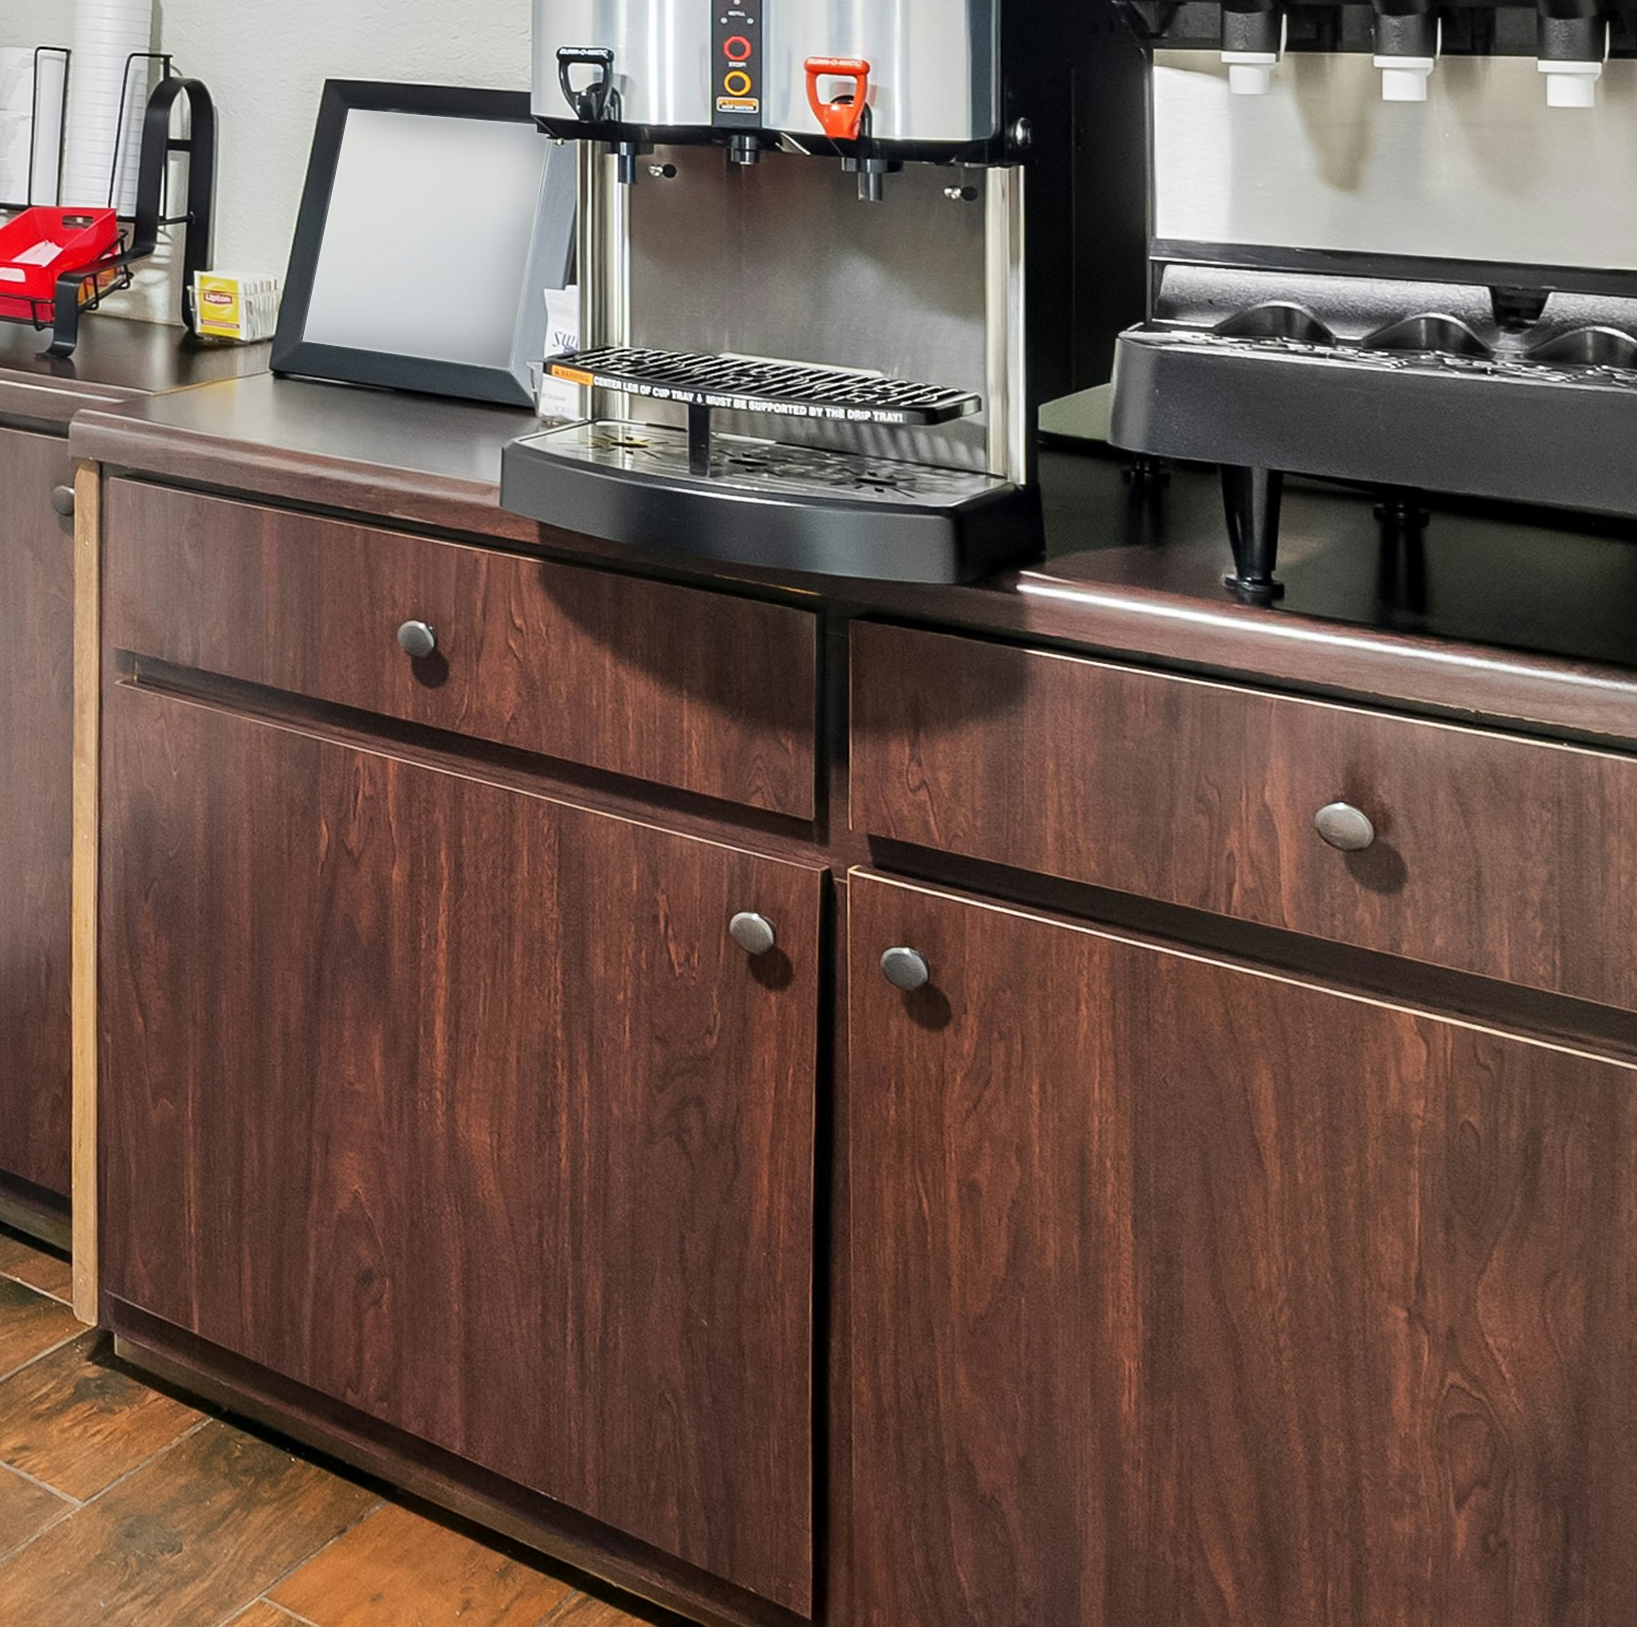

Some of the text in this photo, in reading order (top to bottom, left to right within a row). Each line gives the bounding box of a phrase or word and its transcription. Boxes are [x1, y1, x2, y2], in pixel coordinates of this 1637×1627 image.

[594, 375, 621, 389] CENTER
[640, 385, 651, 395] OF
[652, 387, 670, 398] CUP
[671, 390, 694, 402] TRAY
[706, 395, 732, 407] MUST
[733, 398, 747, 409] BE
[748, 400, 807, 415] SUPPORTED
[808, 406, 823, 417] BY
[825, 407, 845, 419] THE
[847, 409, 871, 421] DRIP
